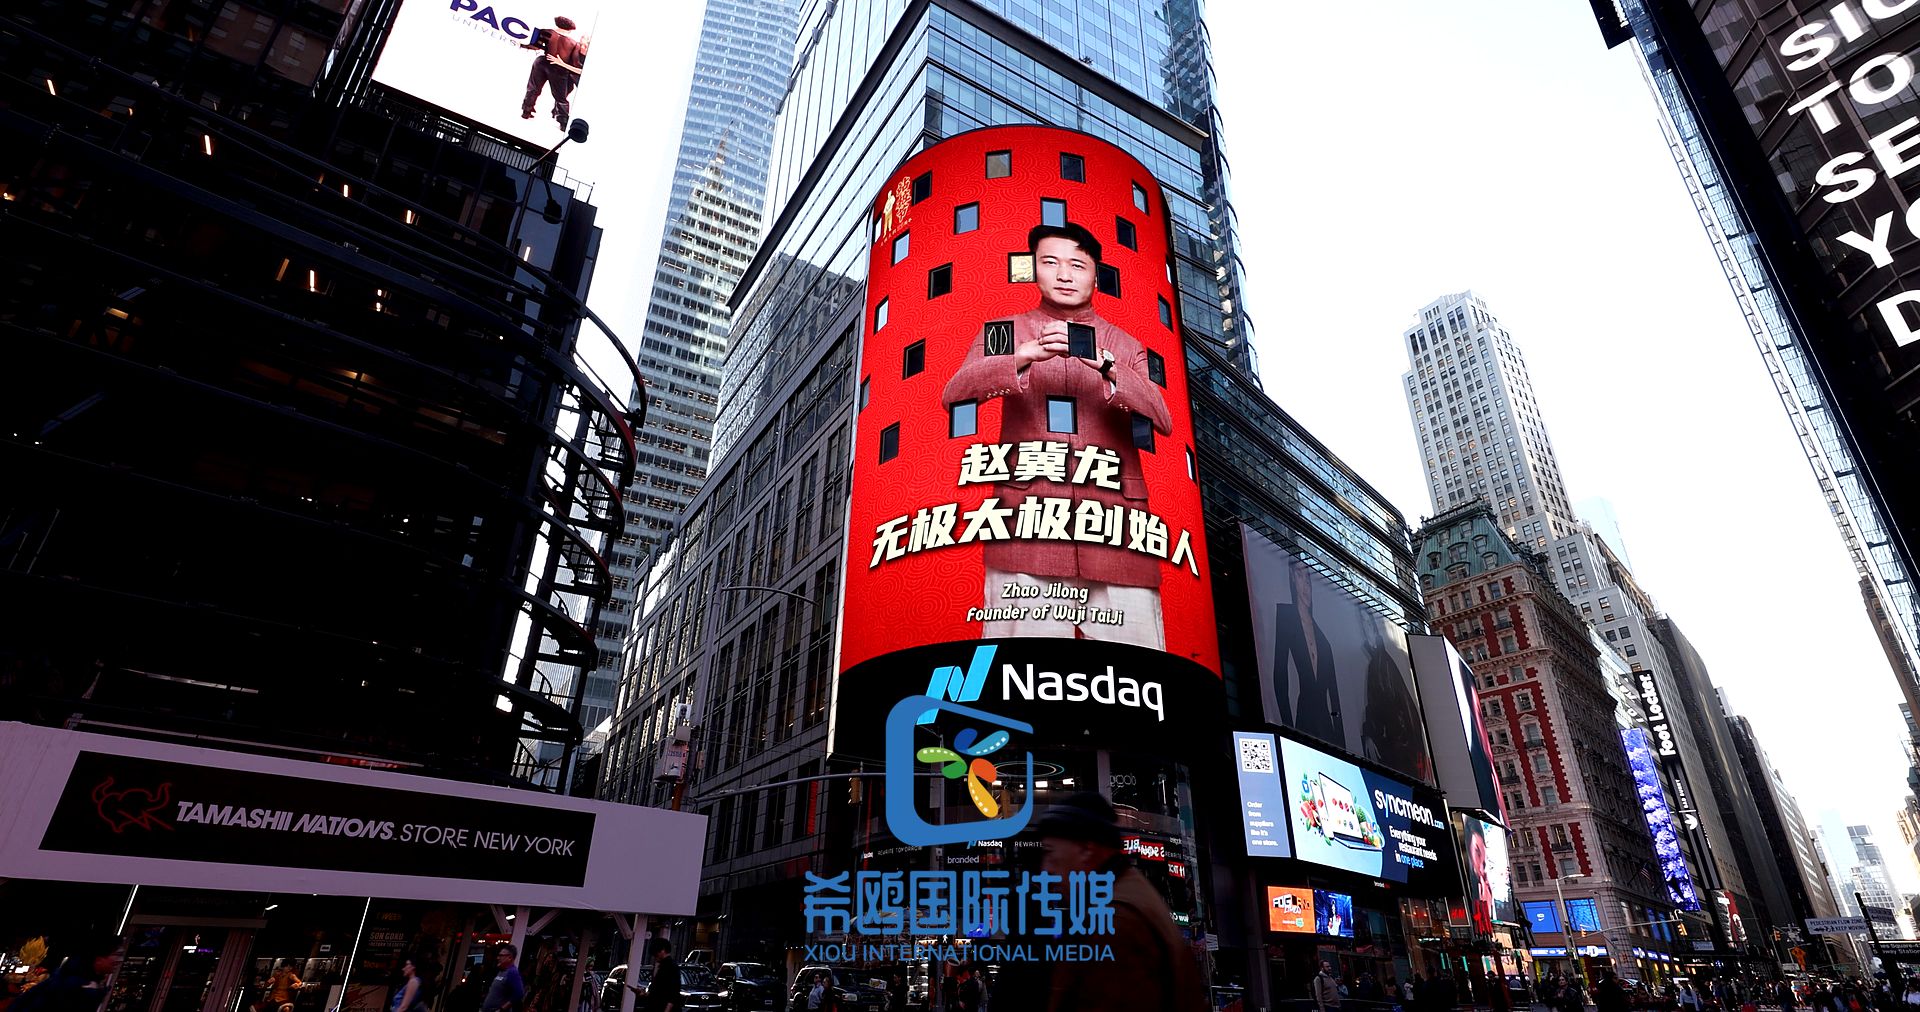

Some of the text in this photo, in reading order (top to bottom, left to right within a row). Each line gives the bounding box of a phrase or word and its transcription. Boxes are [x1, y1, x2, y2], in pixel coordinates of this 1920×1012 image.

[1787, 52, 1914, 134] TO
[1836, 198, 1920, 269] Y
[958, 441, 1121, 490] 赵冀龙
[869, 496, 1199, 577] 无极太极创始人
[967, 605, 1123, 625] Founder of Wuji TaiJi
[1002, 583, 1088, 602] Zhao Jilong
[1003, 664, 1164, 721] Nasdaq
[1639, 673, 1676, 756] Foot Locker
[177, 801, 575, 856] TAMASHII NATIONS STORE NEW YORK
[977, 840, 1003, 848] Nasdaq
[947, 856, 980, 864] branded
[1401, 855, 1411, 865] one
